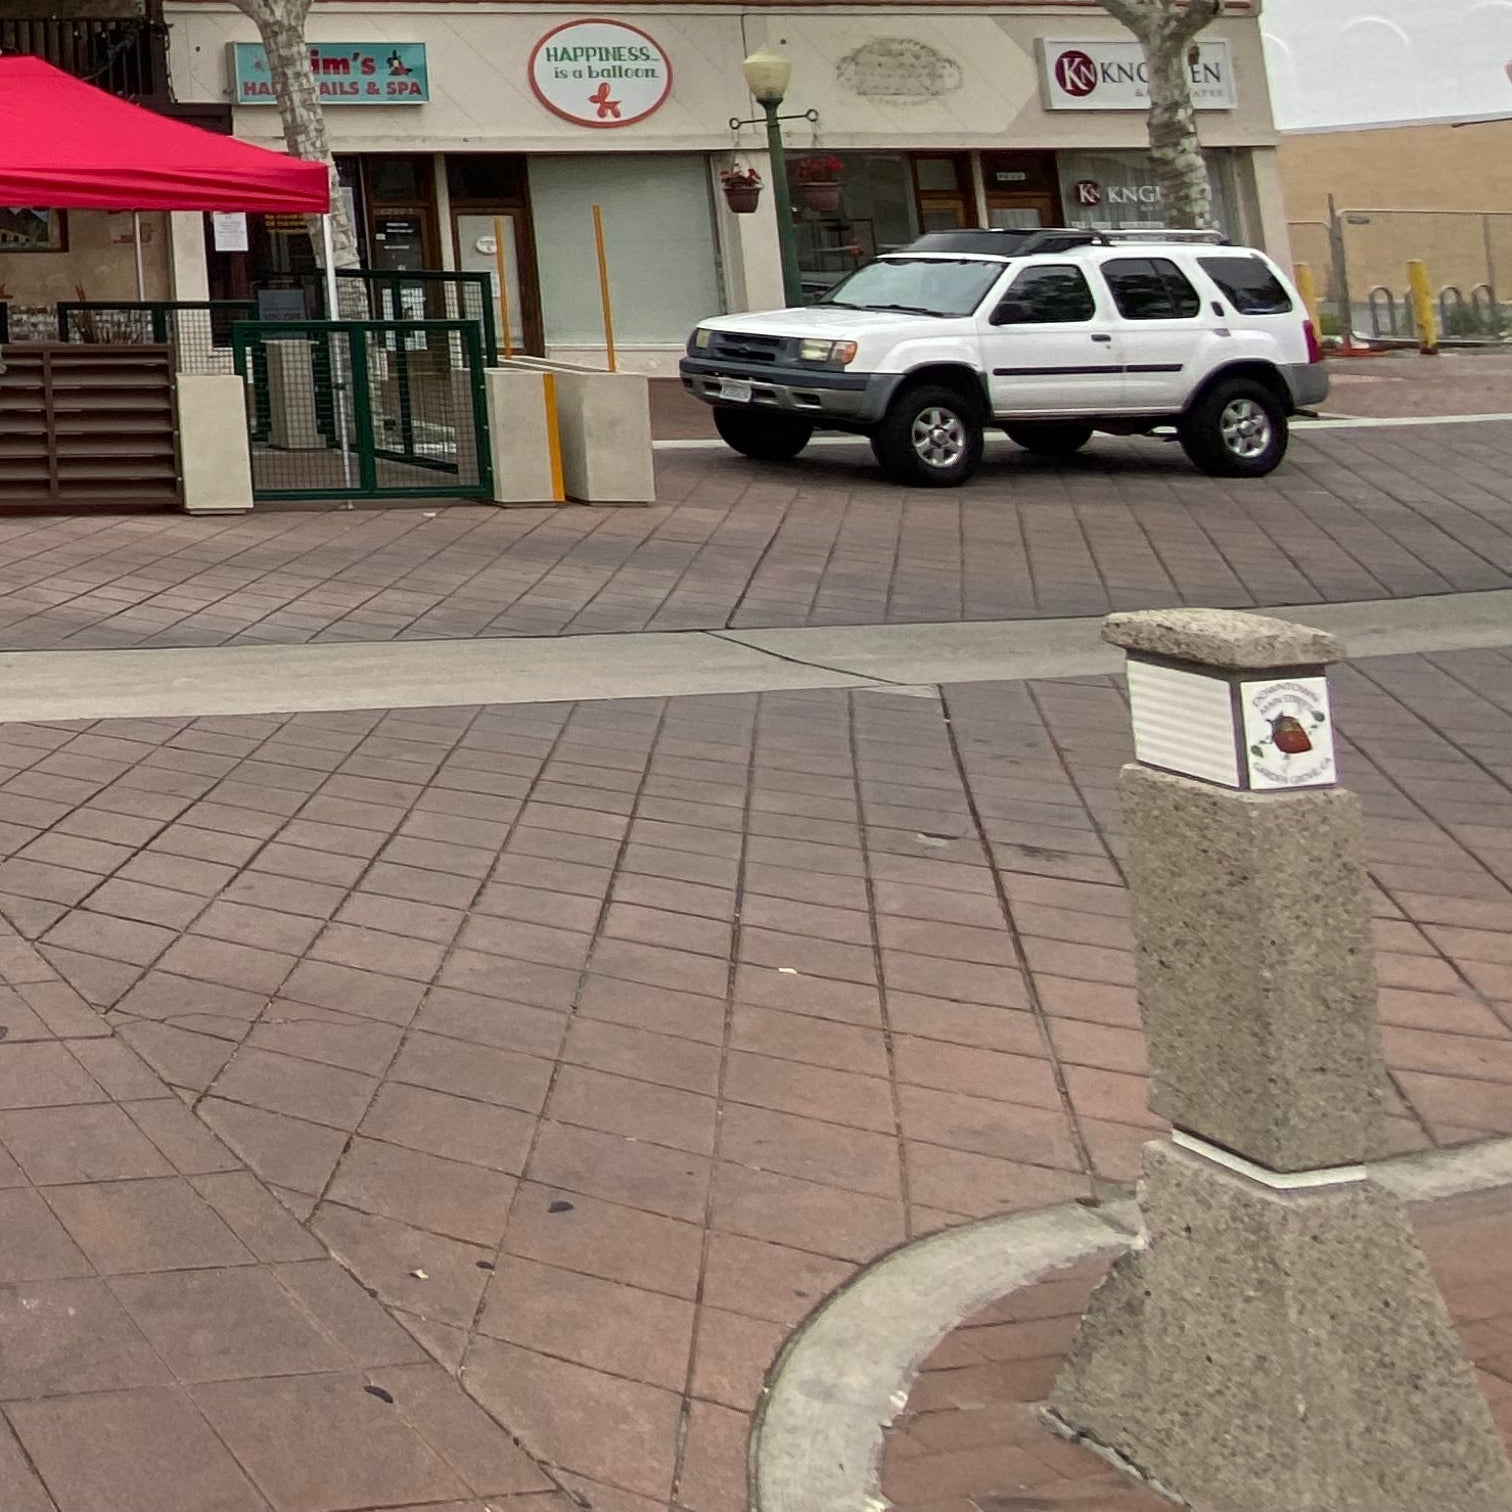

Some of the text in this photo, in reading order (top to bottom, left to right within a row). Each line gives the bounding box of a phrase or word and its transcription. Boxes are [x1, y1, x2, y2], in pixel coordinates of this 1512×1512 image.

[310, 49, 376, 76] im's
[554, 66, 568, 79] is
[572, 68, 583, 79] a
[319, 81, 360, 96] AILS
[366, 82, 381, 96] &
[386, 81, 423, 96] SPA
